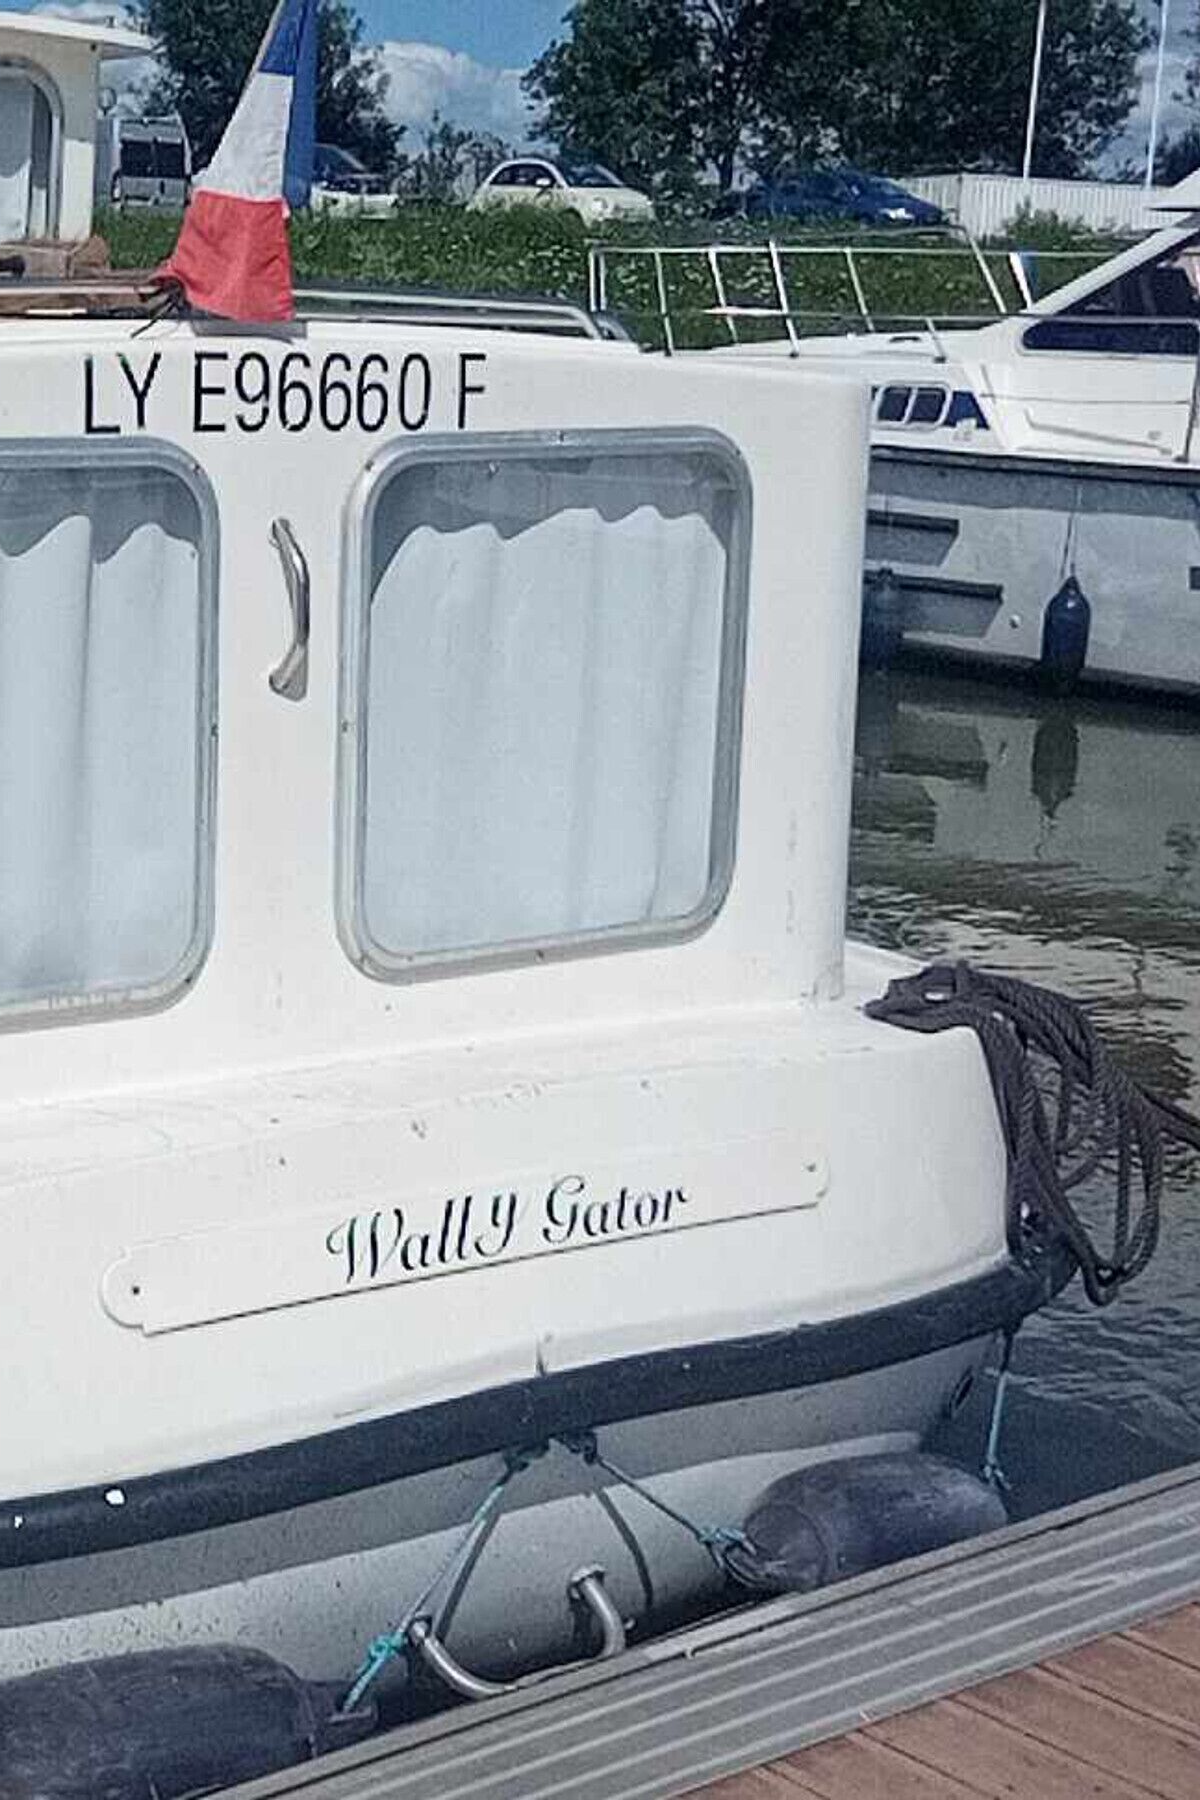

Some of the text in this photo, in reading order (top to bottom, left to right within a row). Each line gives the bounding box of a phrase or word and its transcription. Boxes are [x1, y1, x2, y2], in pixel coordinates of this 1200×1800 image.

[83, 350, 488, 435] LY E96660 F
[542, 1174, 689, 1243] Gator
